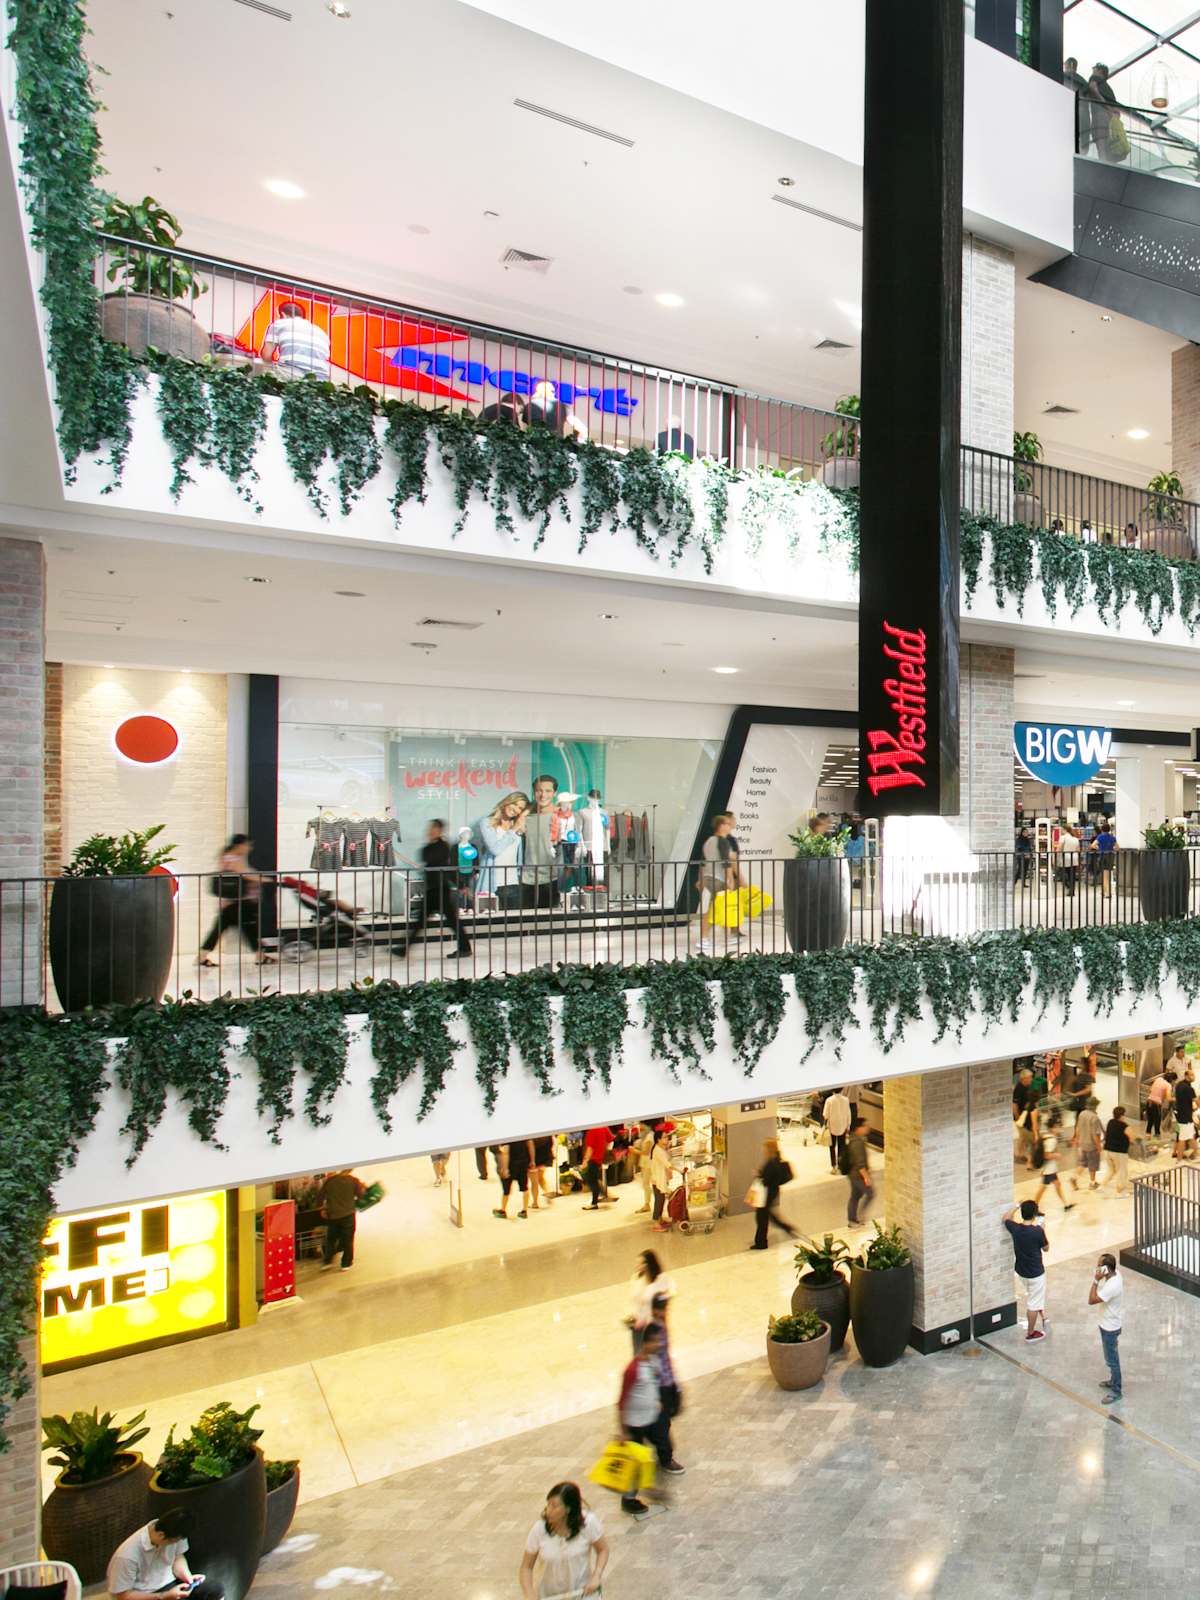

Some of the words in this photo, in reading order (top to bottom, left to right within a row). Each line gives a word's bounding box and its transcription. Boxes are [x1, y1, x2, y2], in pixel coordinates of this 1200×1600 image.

[866, 620, 926, 796] Westfield
[409, 758, 455, 767] THINK
[471, 759, 504, 768] EASY
[404, 752, 519, 797] weekend
[750, 778, 771, 786] Beauty
[418, 790, 460, 799] STYLE
[736, 824, 752, 832] Party
[43, 1270, 147, 1318] ME
